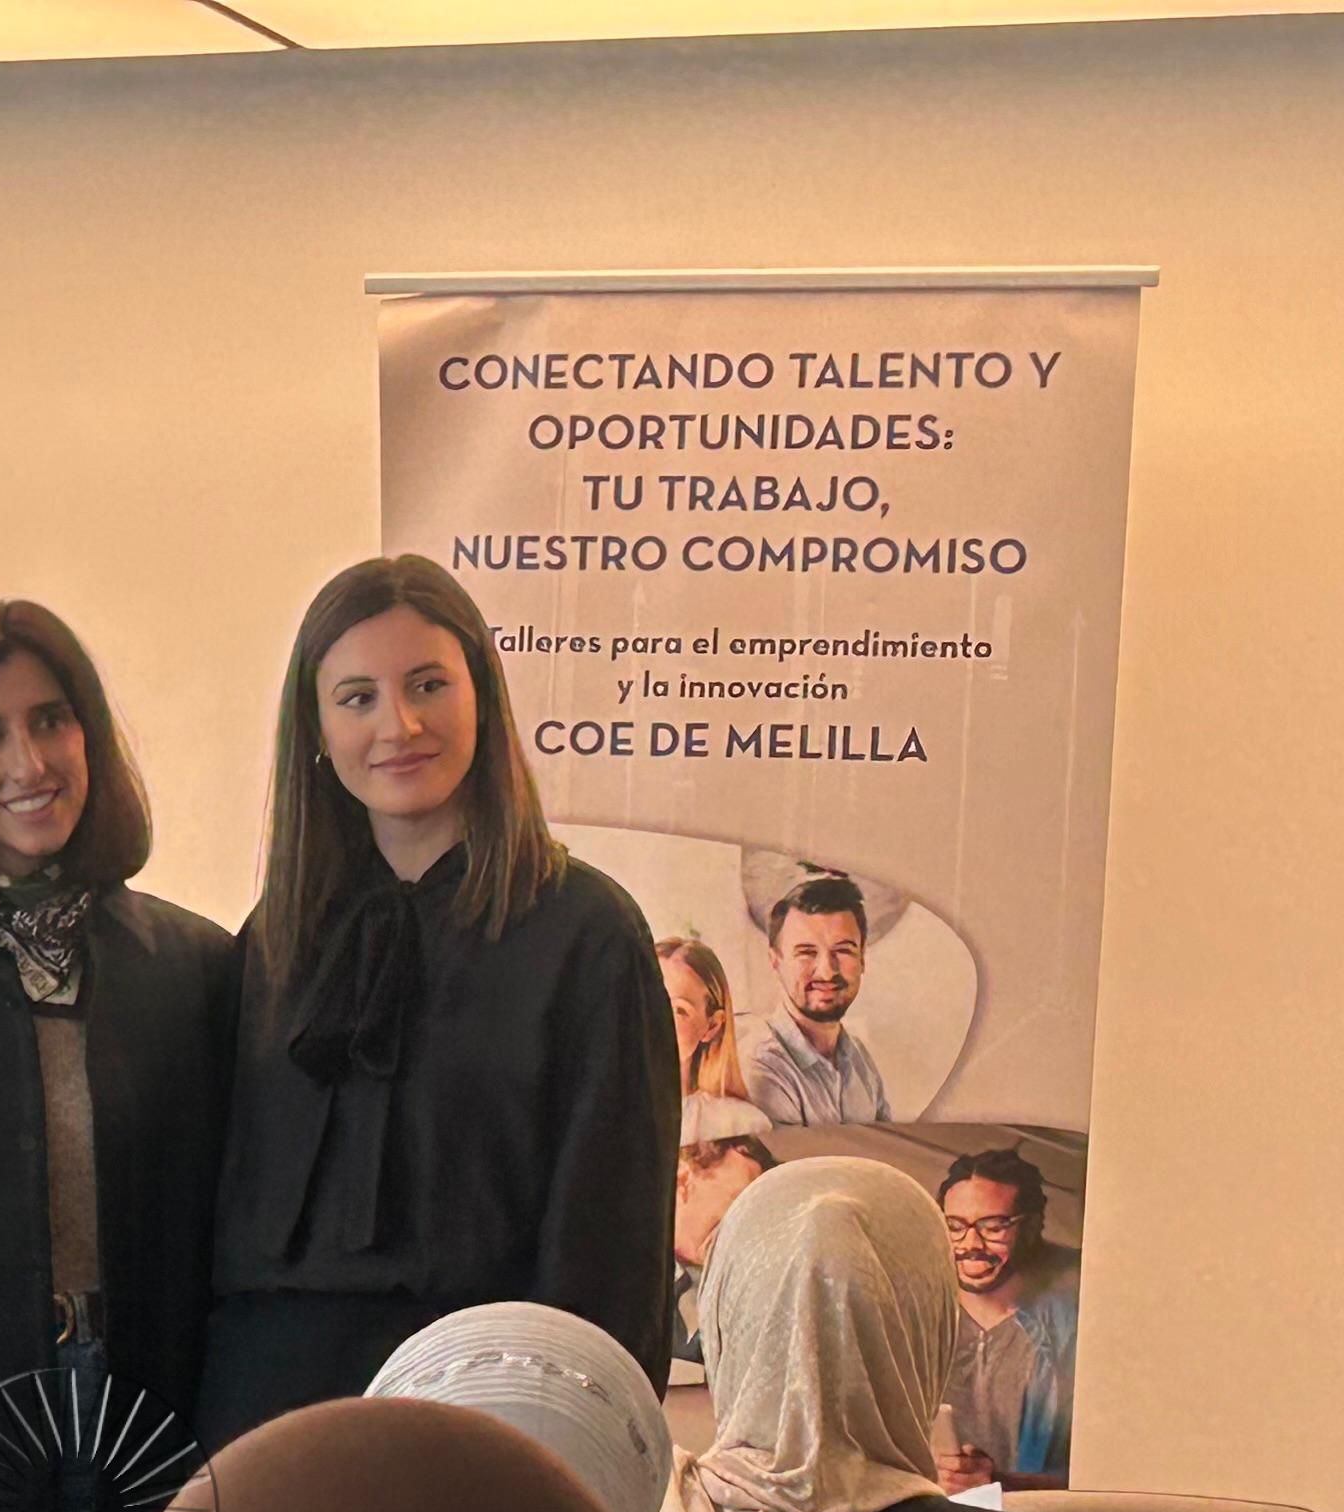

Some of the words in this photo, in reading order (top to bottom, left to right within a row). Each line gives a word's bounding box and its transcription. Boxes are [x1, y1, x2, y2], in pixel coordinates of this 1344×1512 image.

[438, 352, 775, 391] CONECTANDO
[789, 351, 1013, 389] TALENTO
[1028, 351, 1061, 388] Y
[528, 414, 954, 451] OPORTUNIDADES:
[584, 475, 644, 511] TU
[658, 475, 891, 518] TRABAJO,
[453, 534, 667, 571] NUESTRO
[682, 537, 1028, 575] COMPROMISO
[611, 636, 683, 661] para
[692, 627, 719, 655] el
[729, 630, 993, 662] emprendimiento
[618, 679, 634, 704] y
[643, 670, 669, 698] la
[680, 672, 849, 701] innovación
[534, 720, 635, 756] COE
[650, 722, 710, 757] DE
[725, 723, 928, 764] MELILLA
